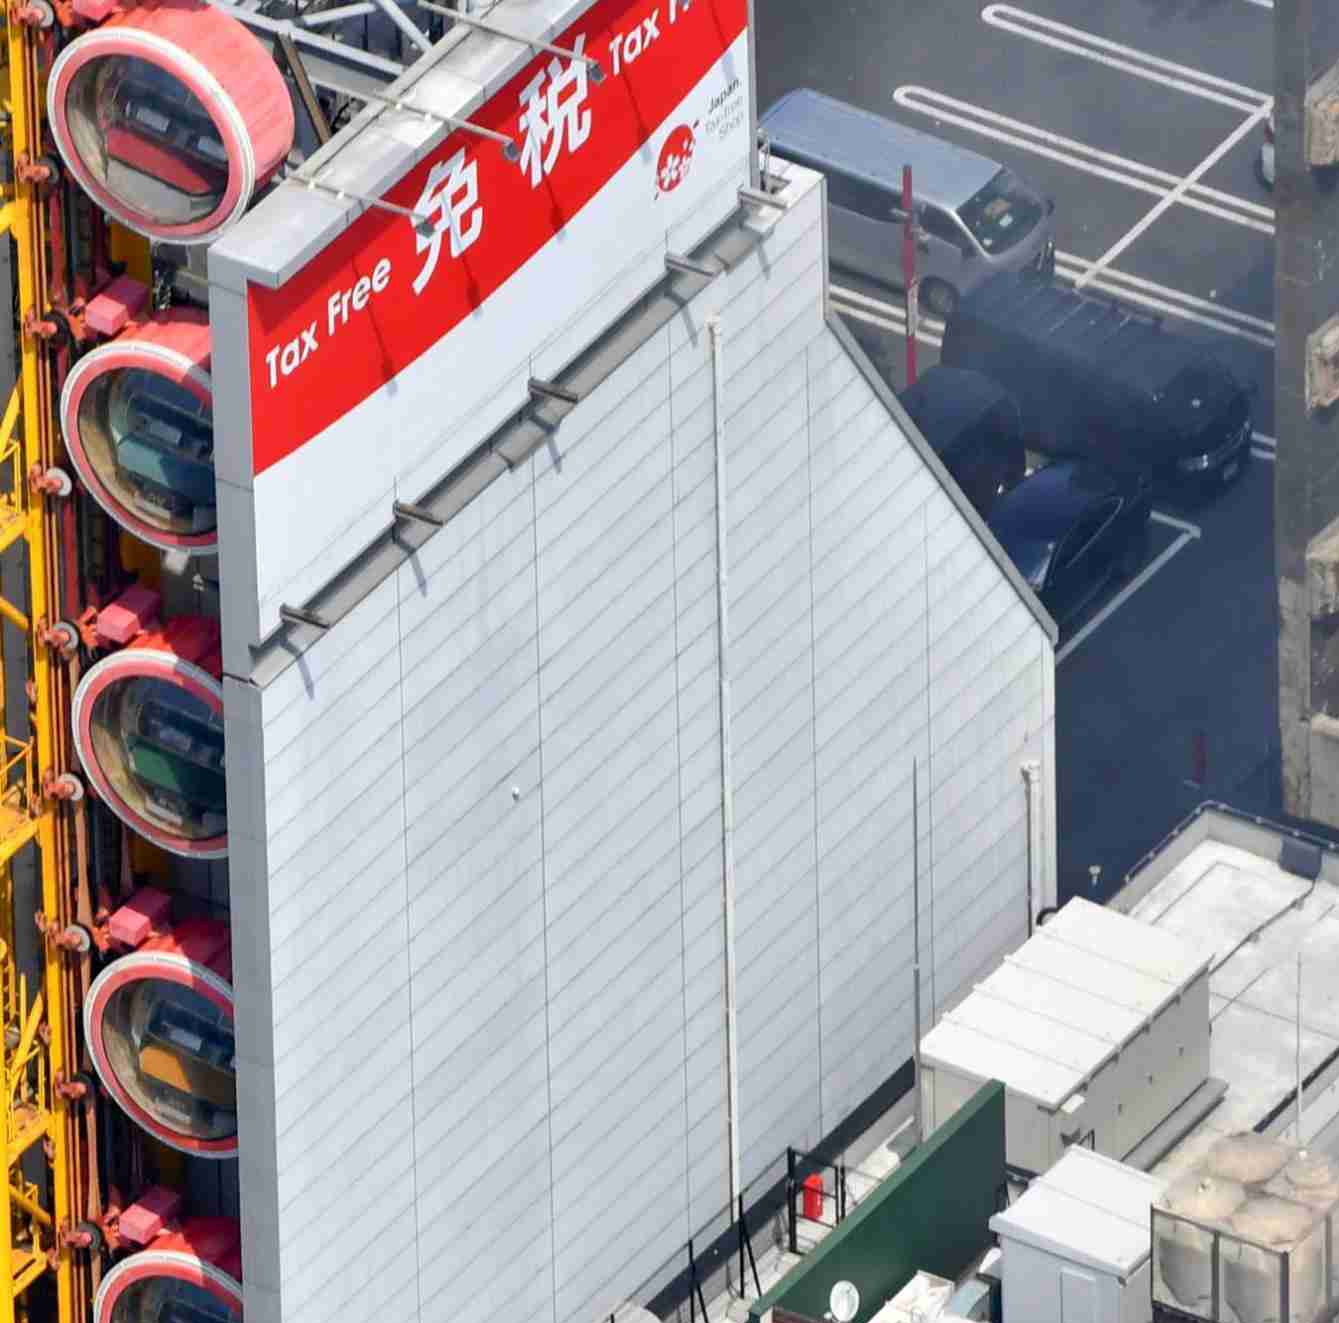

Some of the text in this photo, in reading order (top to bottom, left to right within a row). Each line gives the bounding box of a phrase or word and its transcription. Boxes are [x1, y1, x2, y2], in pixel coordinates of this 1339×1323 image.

[608, 8, 660, 76] Tax
[265, 255, 392, 389] Tax Free
